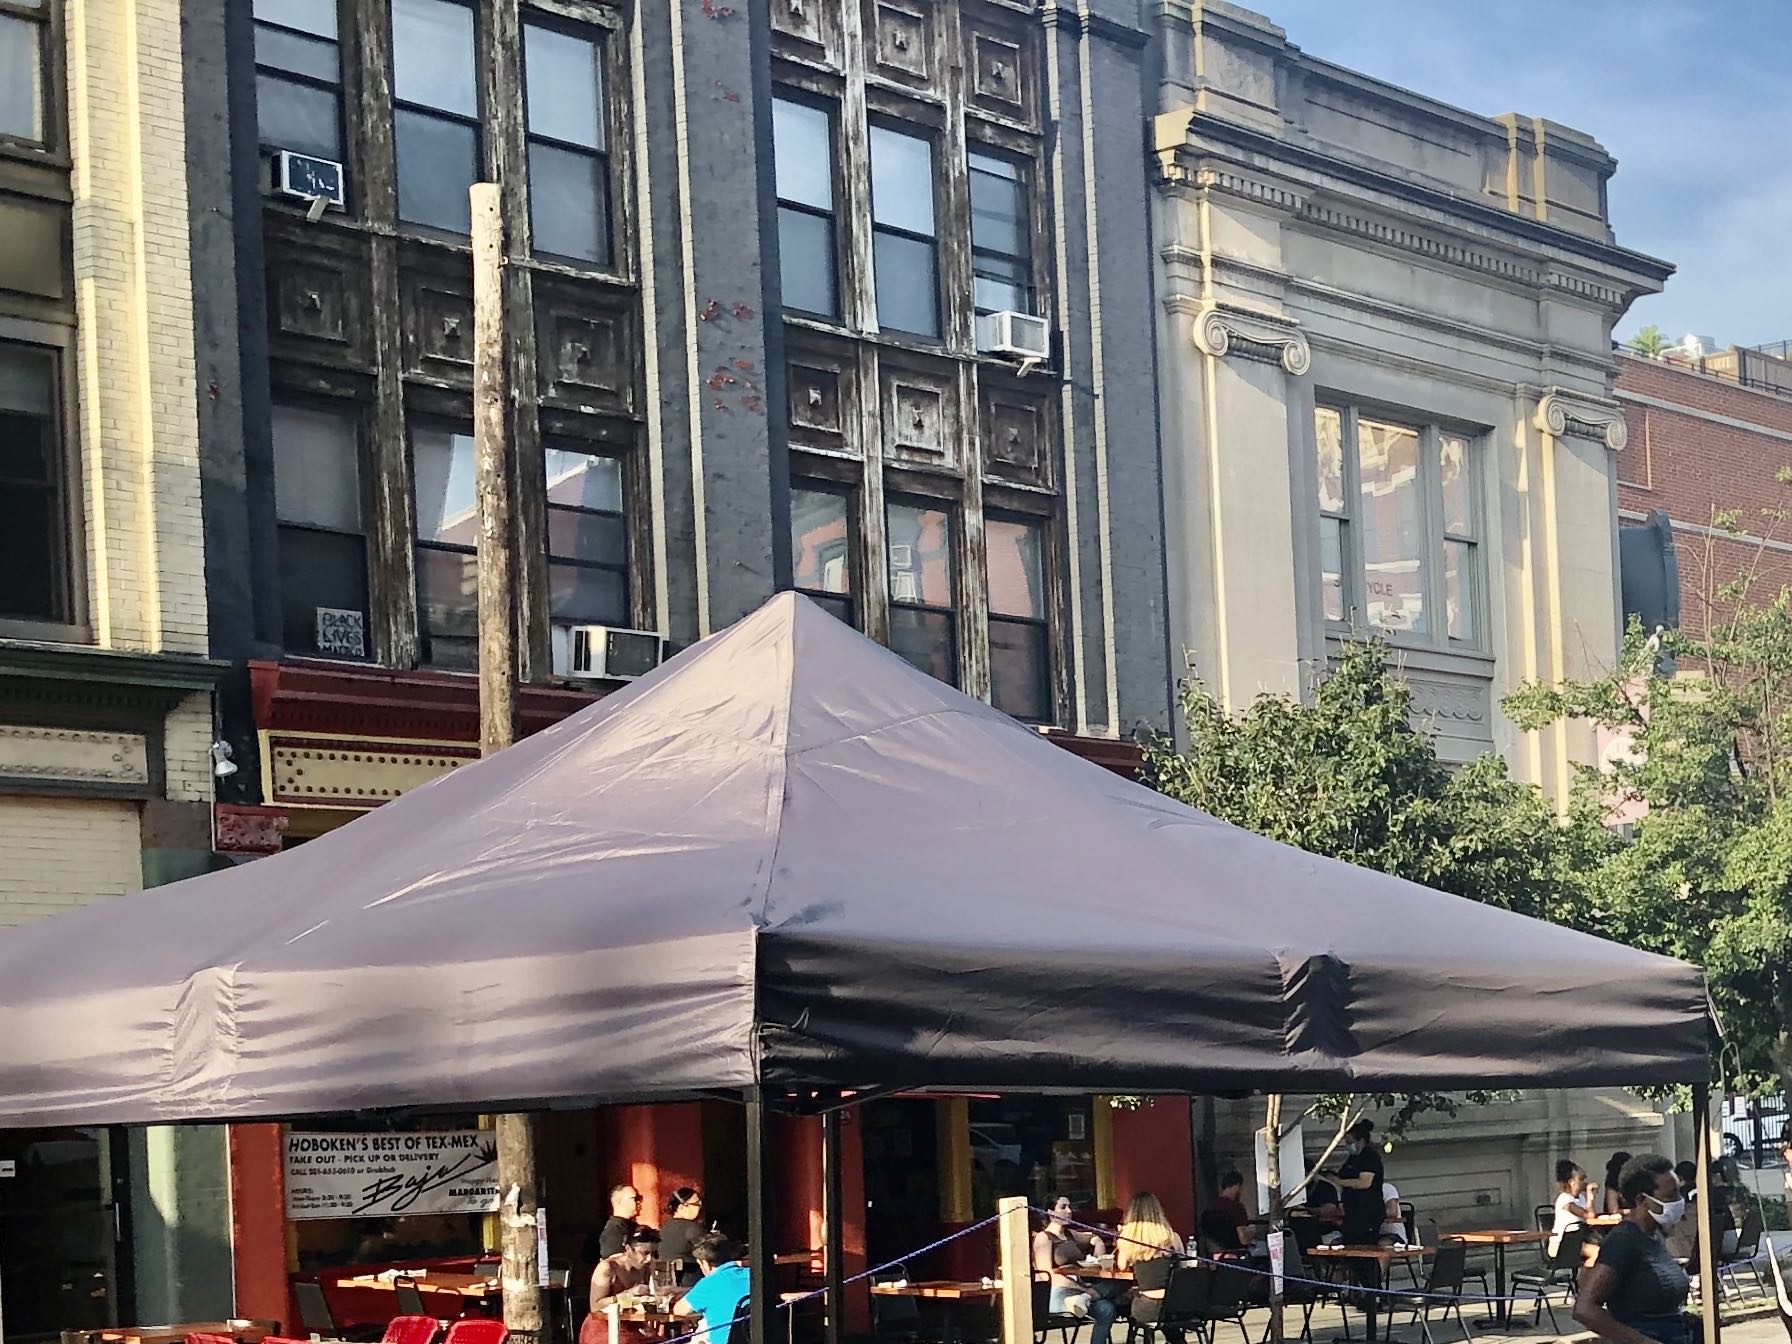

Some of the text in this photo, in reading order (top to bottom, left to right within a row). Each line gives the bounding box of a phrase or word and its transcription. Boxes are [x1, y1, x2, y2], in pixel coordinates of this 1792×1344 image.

[322, 612, 362, 628] BLACK
[323, 629, 362, 645] LIVES
[288, 1135, 478, 1152] HOBOKEN'S BEST OF TEX-MEX
[289, 1155, 312, 1164] TAKE
[315, 1155, 336, 1164] OUT
[344, 1155, 364, 1163] PICK
[368, 1154, 381, 1162] UP
[383, 1154, 396, 1162] OR
[399, 1153, 439, 1161] DELIVERY
